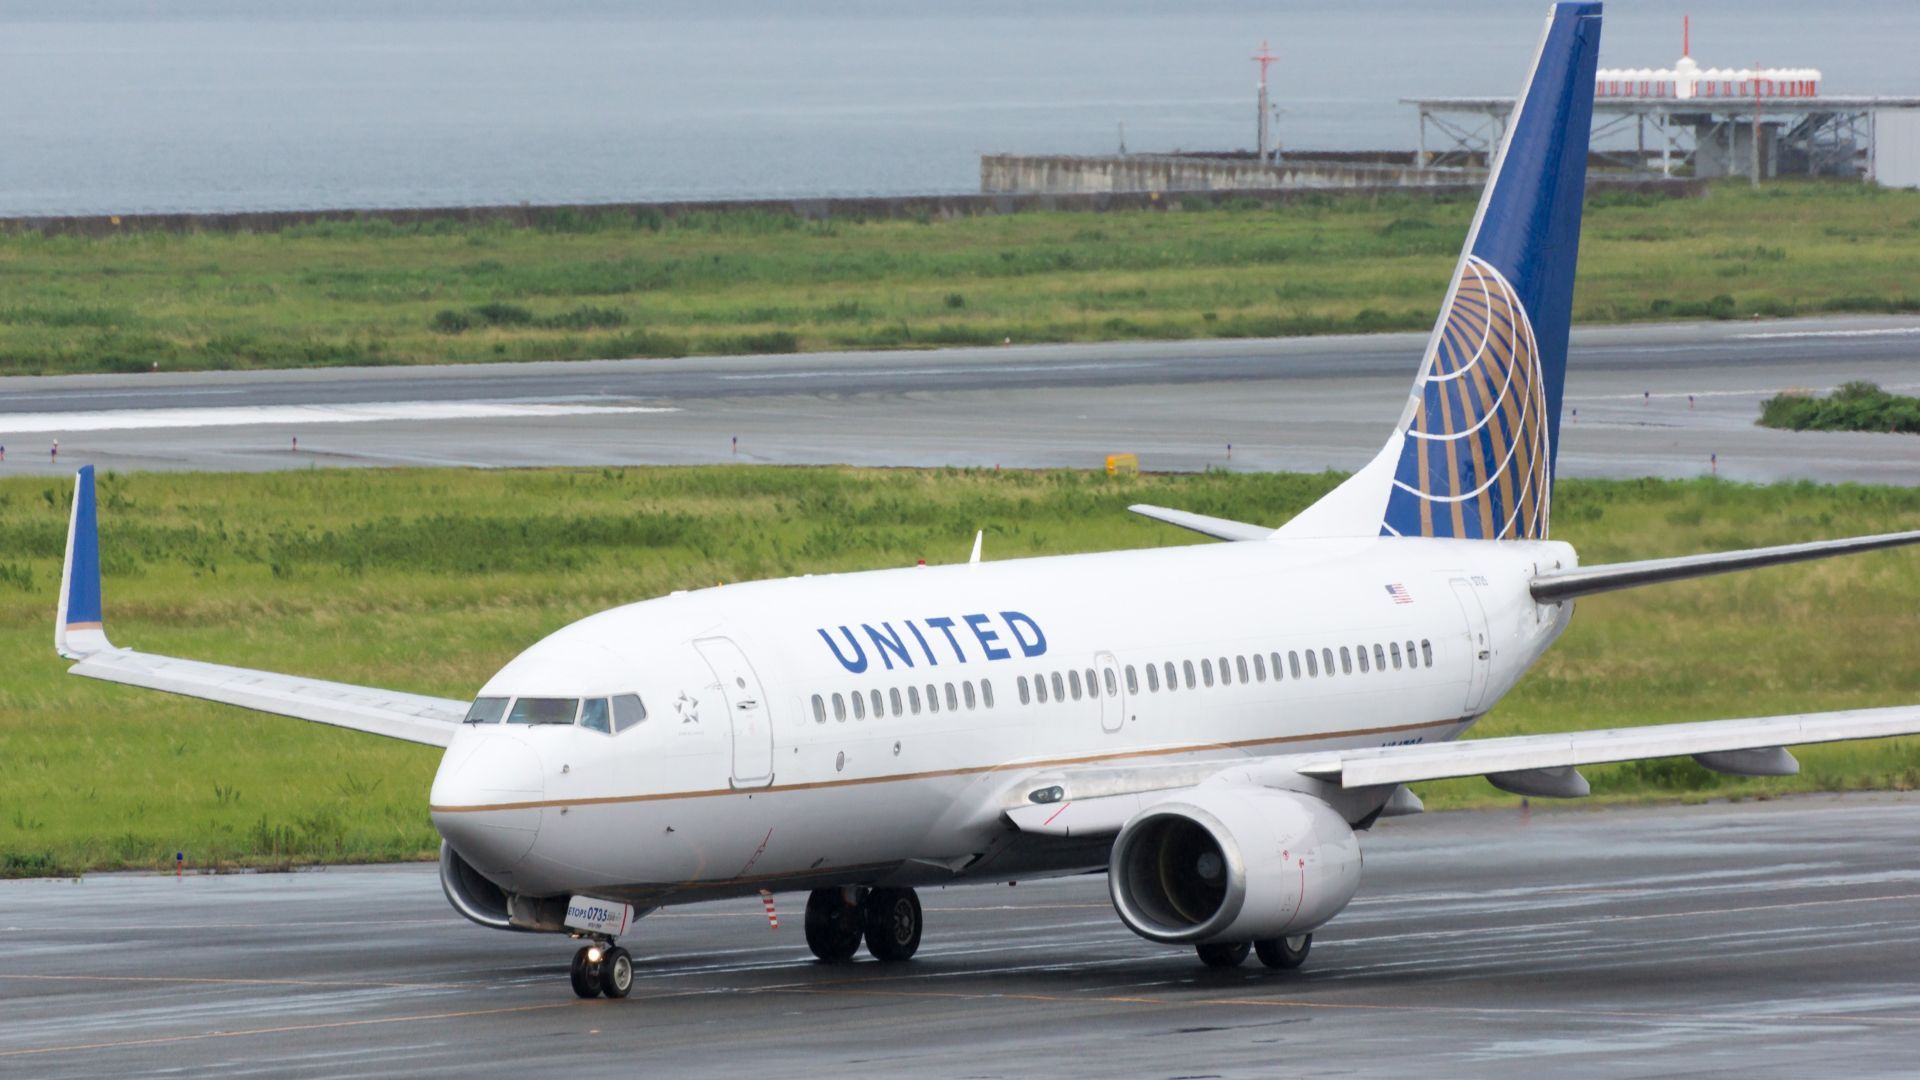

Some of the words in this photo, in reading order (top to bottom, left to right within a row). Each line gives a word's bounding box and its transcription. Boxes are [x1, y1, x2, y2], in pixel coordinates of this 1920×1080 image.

[816, 611, 1047, 674] UNITED
[568, 906, 587, 919] ETOPS
[587, 906, 608, 922] 0735
